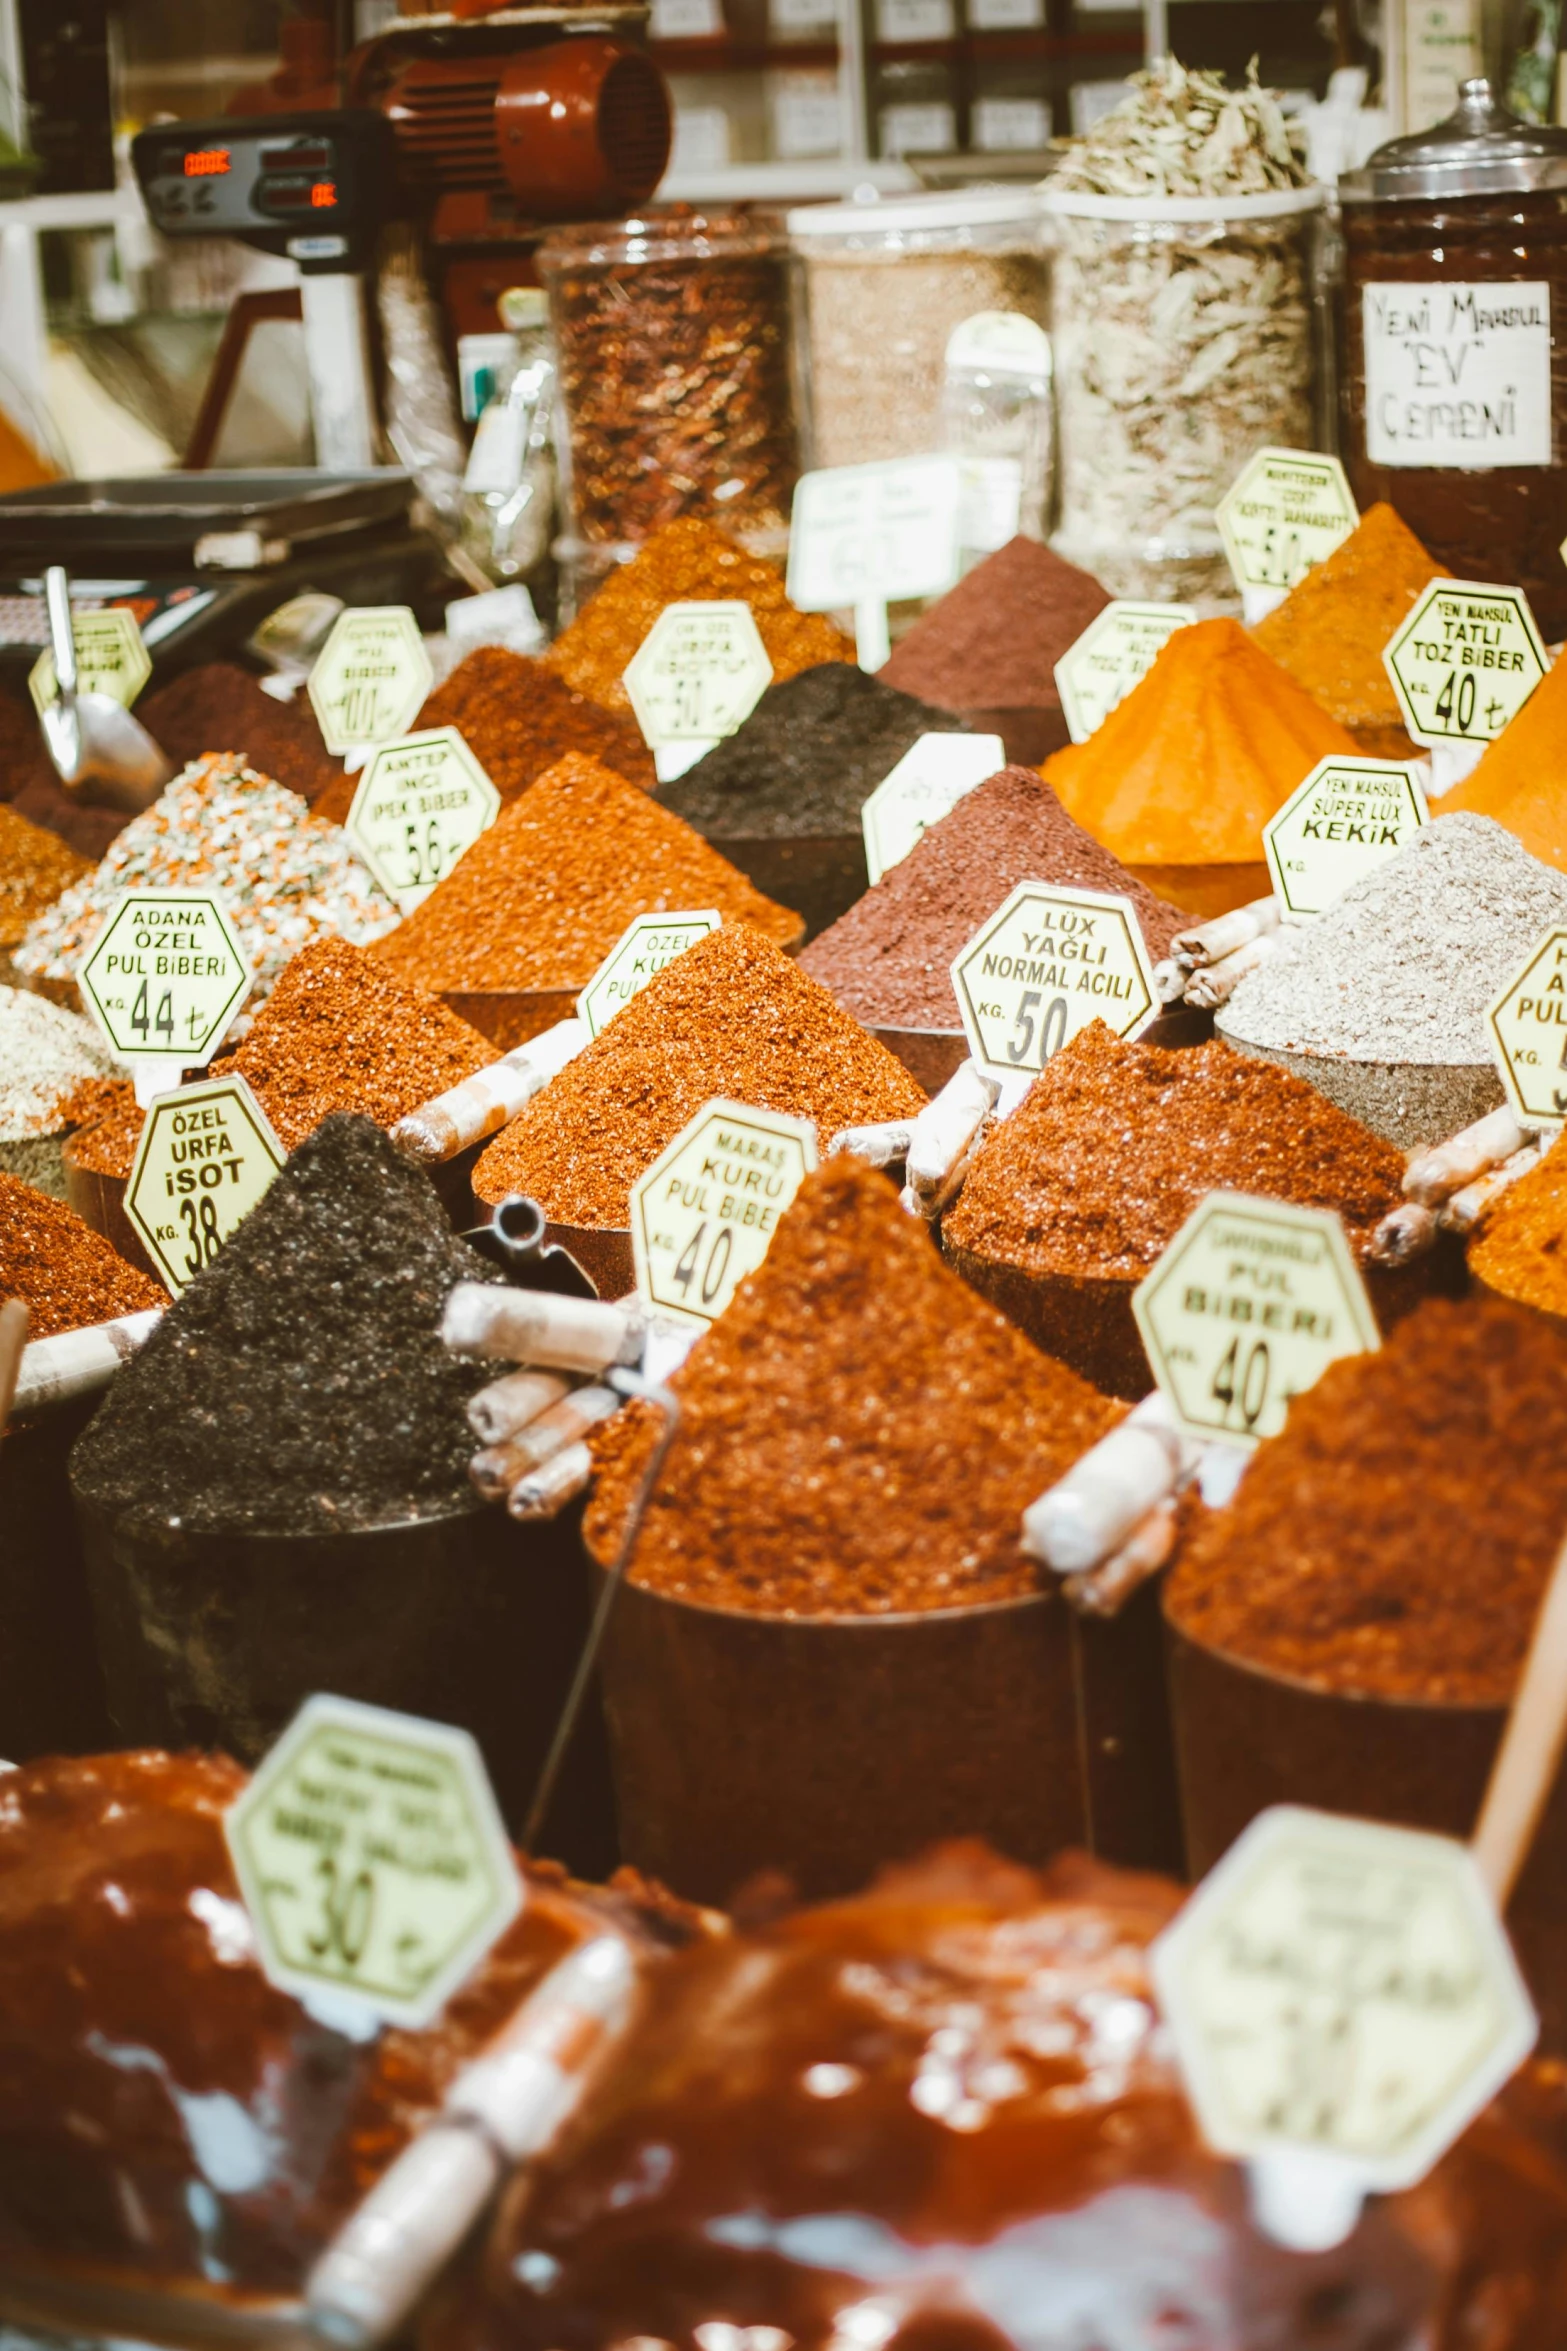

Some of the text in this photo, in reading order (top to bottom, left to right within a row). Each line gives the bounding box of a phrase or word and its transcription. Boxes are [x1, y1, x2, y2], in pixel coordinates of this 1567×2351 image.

[1443, 621, 1501, 645] TATLI
[1413, 641, 1452, 663] TOZ
[1435, 671, 1476, 735] 40
[385, 751, 448, 773] ANTEP
[1312, 796, 1365, 819] SÜPER
[407, 820, 441, 884] 56
[132, 911, 206, 926] ADANA
[1042, 911, 1097, 937] LÜX
[135, 928, 202, 949] ÖZEL
[1022, 932, 1107, 965] YAĞLI
[106, 955, 147, 975] PUL
[632, 955, 674, 974] KU
[981, 953, 1133, 1000] NORMAL ACILI
[131, 978, 174, 1045] 44
[978, 990, 1068, 1069] KG. 50
[1513, 1048, 1542, 1066] KG.
[172, 1107, 227, 1135] ÖZEL
[171, 1132, 233, 1164] URFA
[701, 1158, 785, 1198] KURU
[666, 1179, 708, 1213] PUL
[156, 1195, 224, 1276] KG. 38
[673, 1221, 733, 1304] 40
[1228, 1261, 1294, 1297] PUL
[1212, 1334, 1271, 1432] 40
